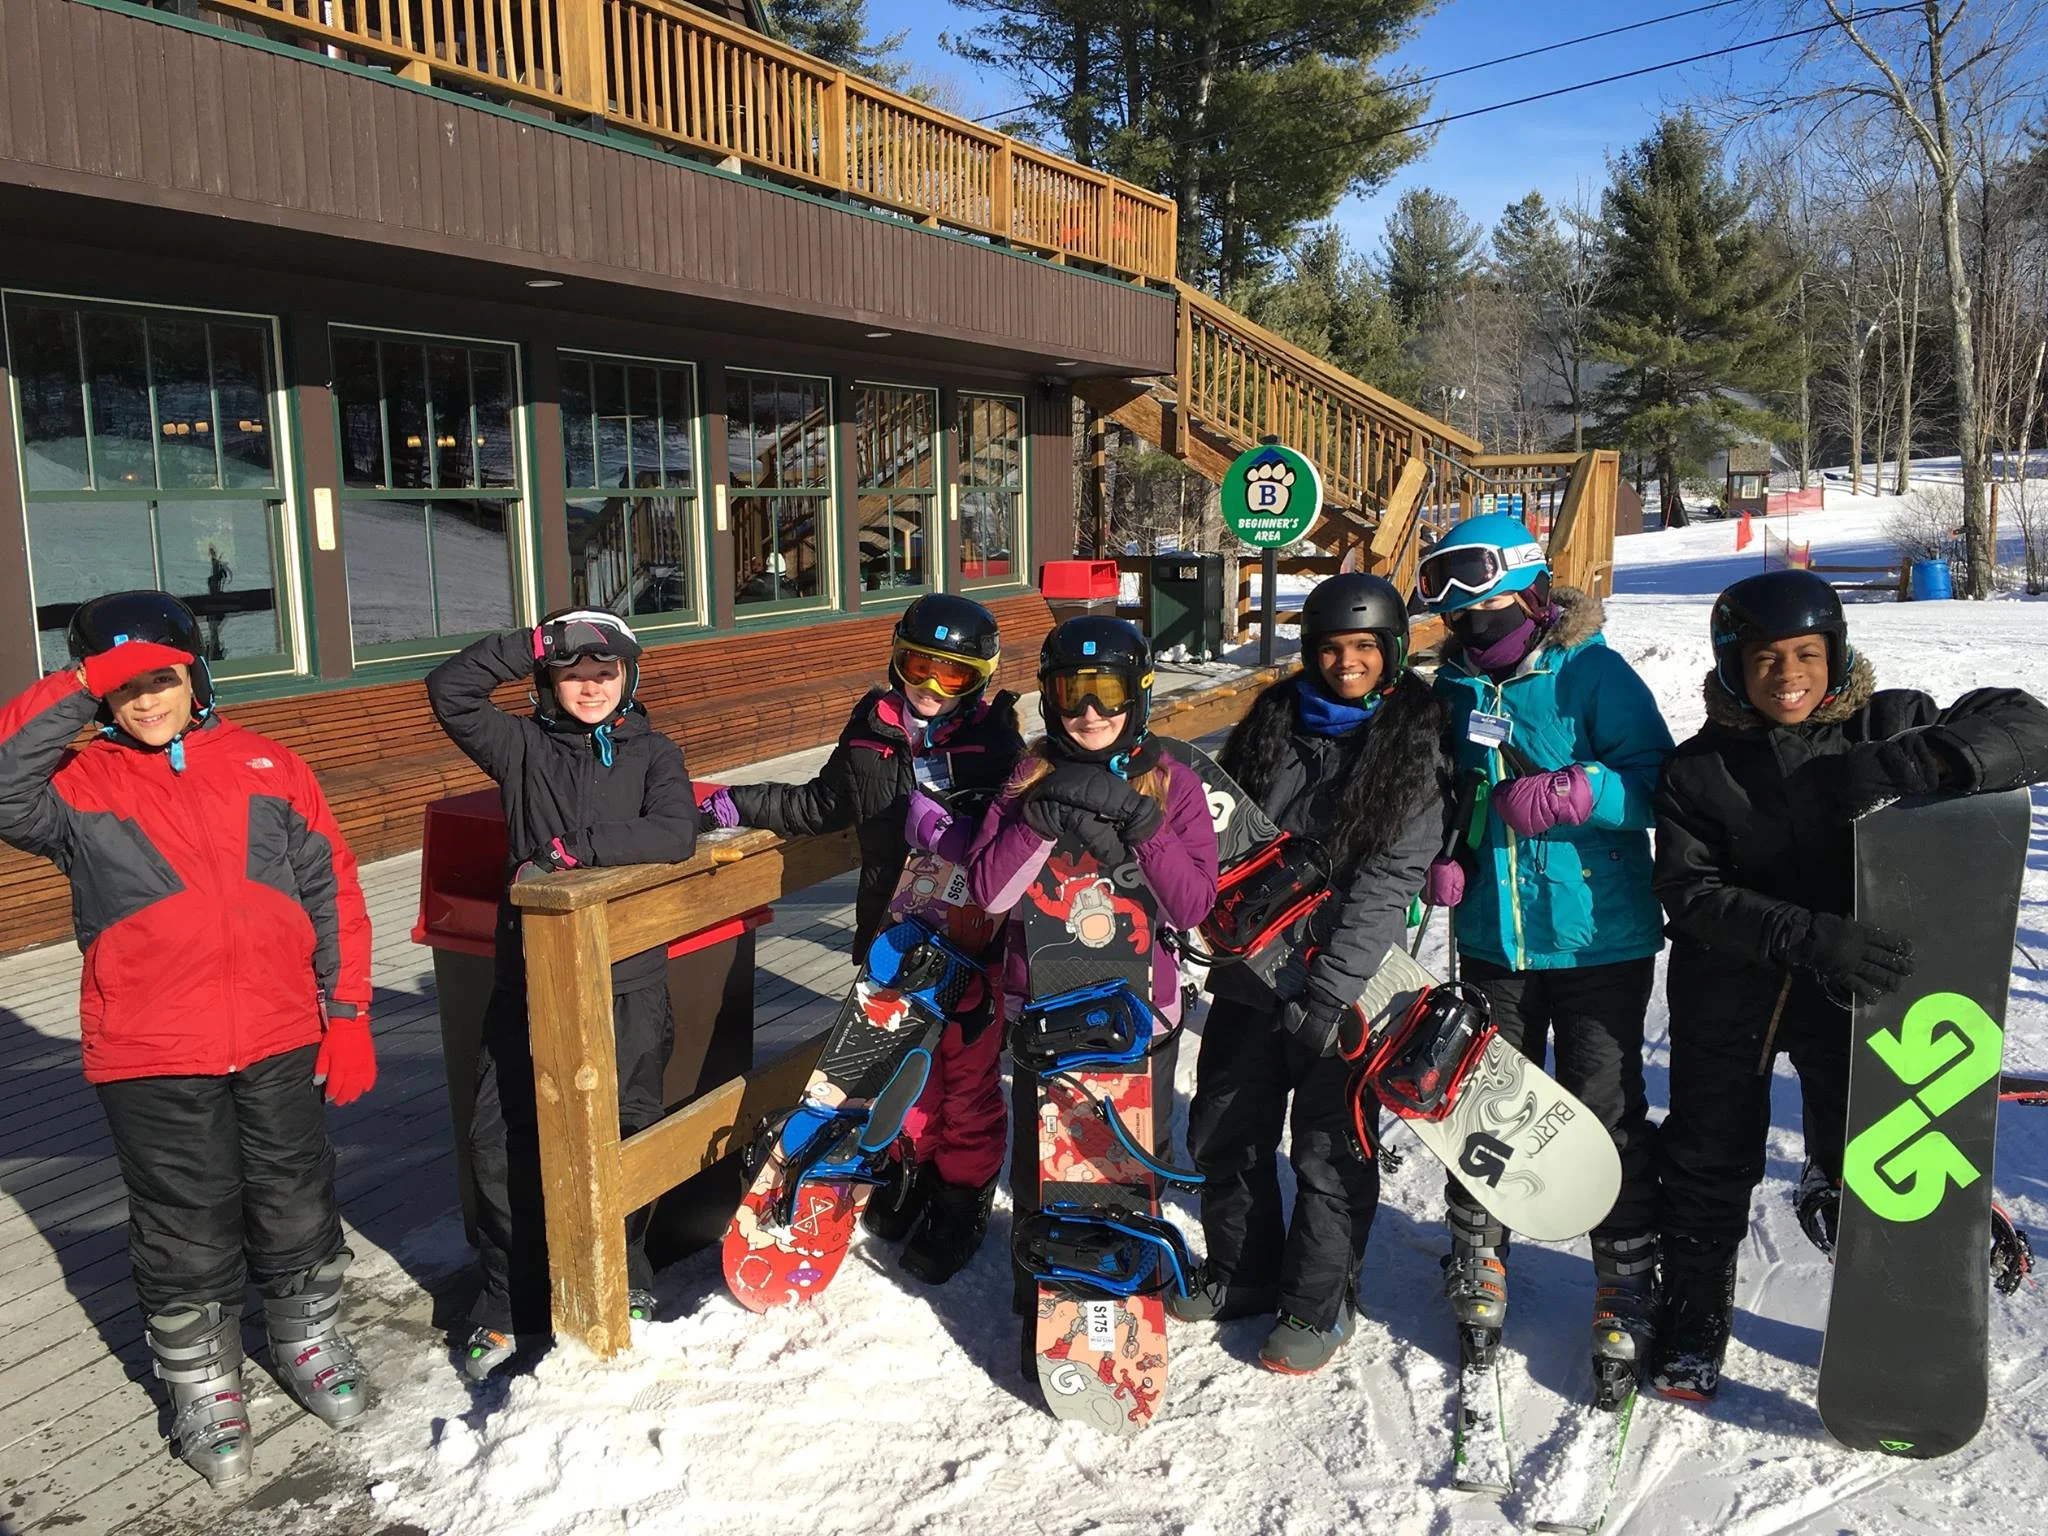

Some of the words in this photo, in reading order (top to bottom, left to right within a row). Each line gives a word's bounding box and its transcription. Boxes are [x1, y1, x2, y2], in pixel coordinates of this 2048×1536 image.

[1258, 484, 1277, 506] B
[1238, 518, 1299, 529] BEGINNER'S
[1254, 530, 1281, 542] AREA
[947, 874, 967, 901] S652
[1093, 1305, 1108, 1333] S175
